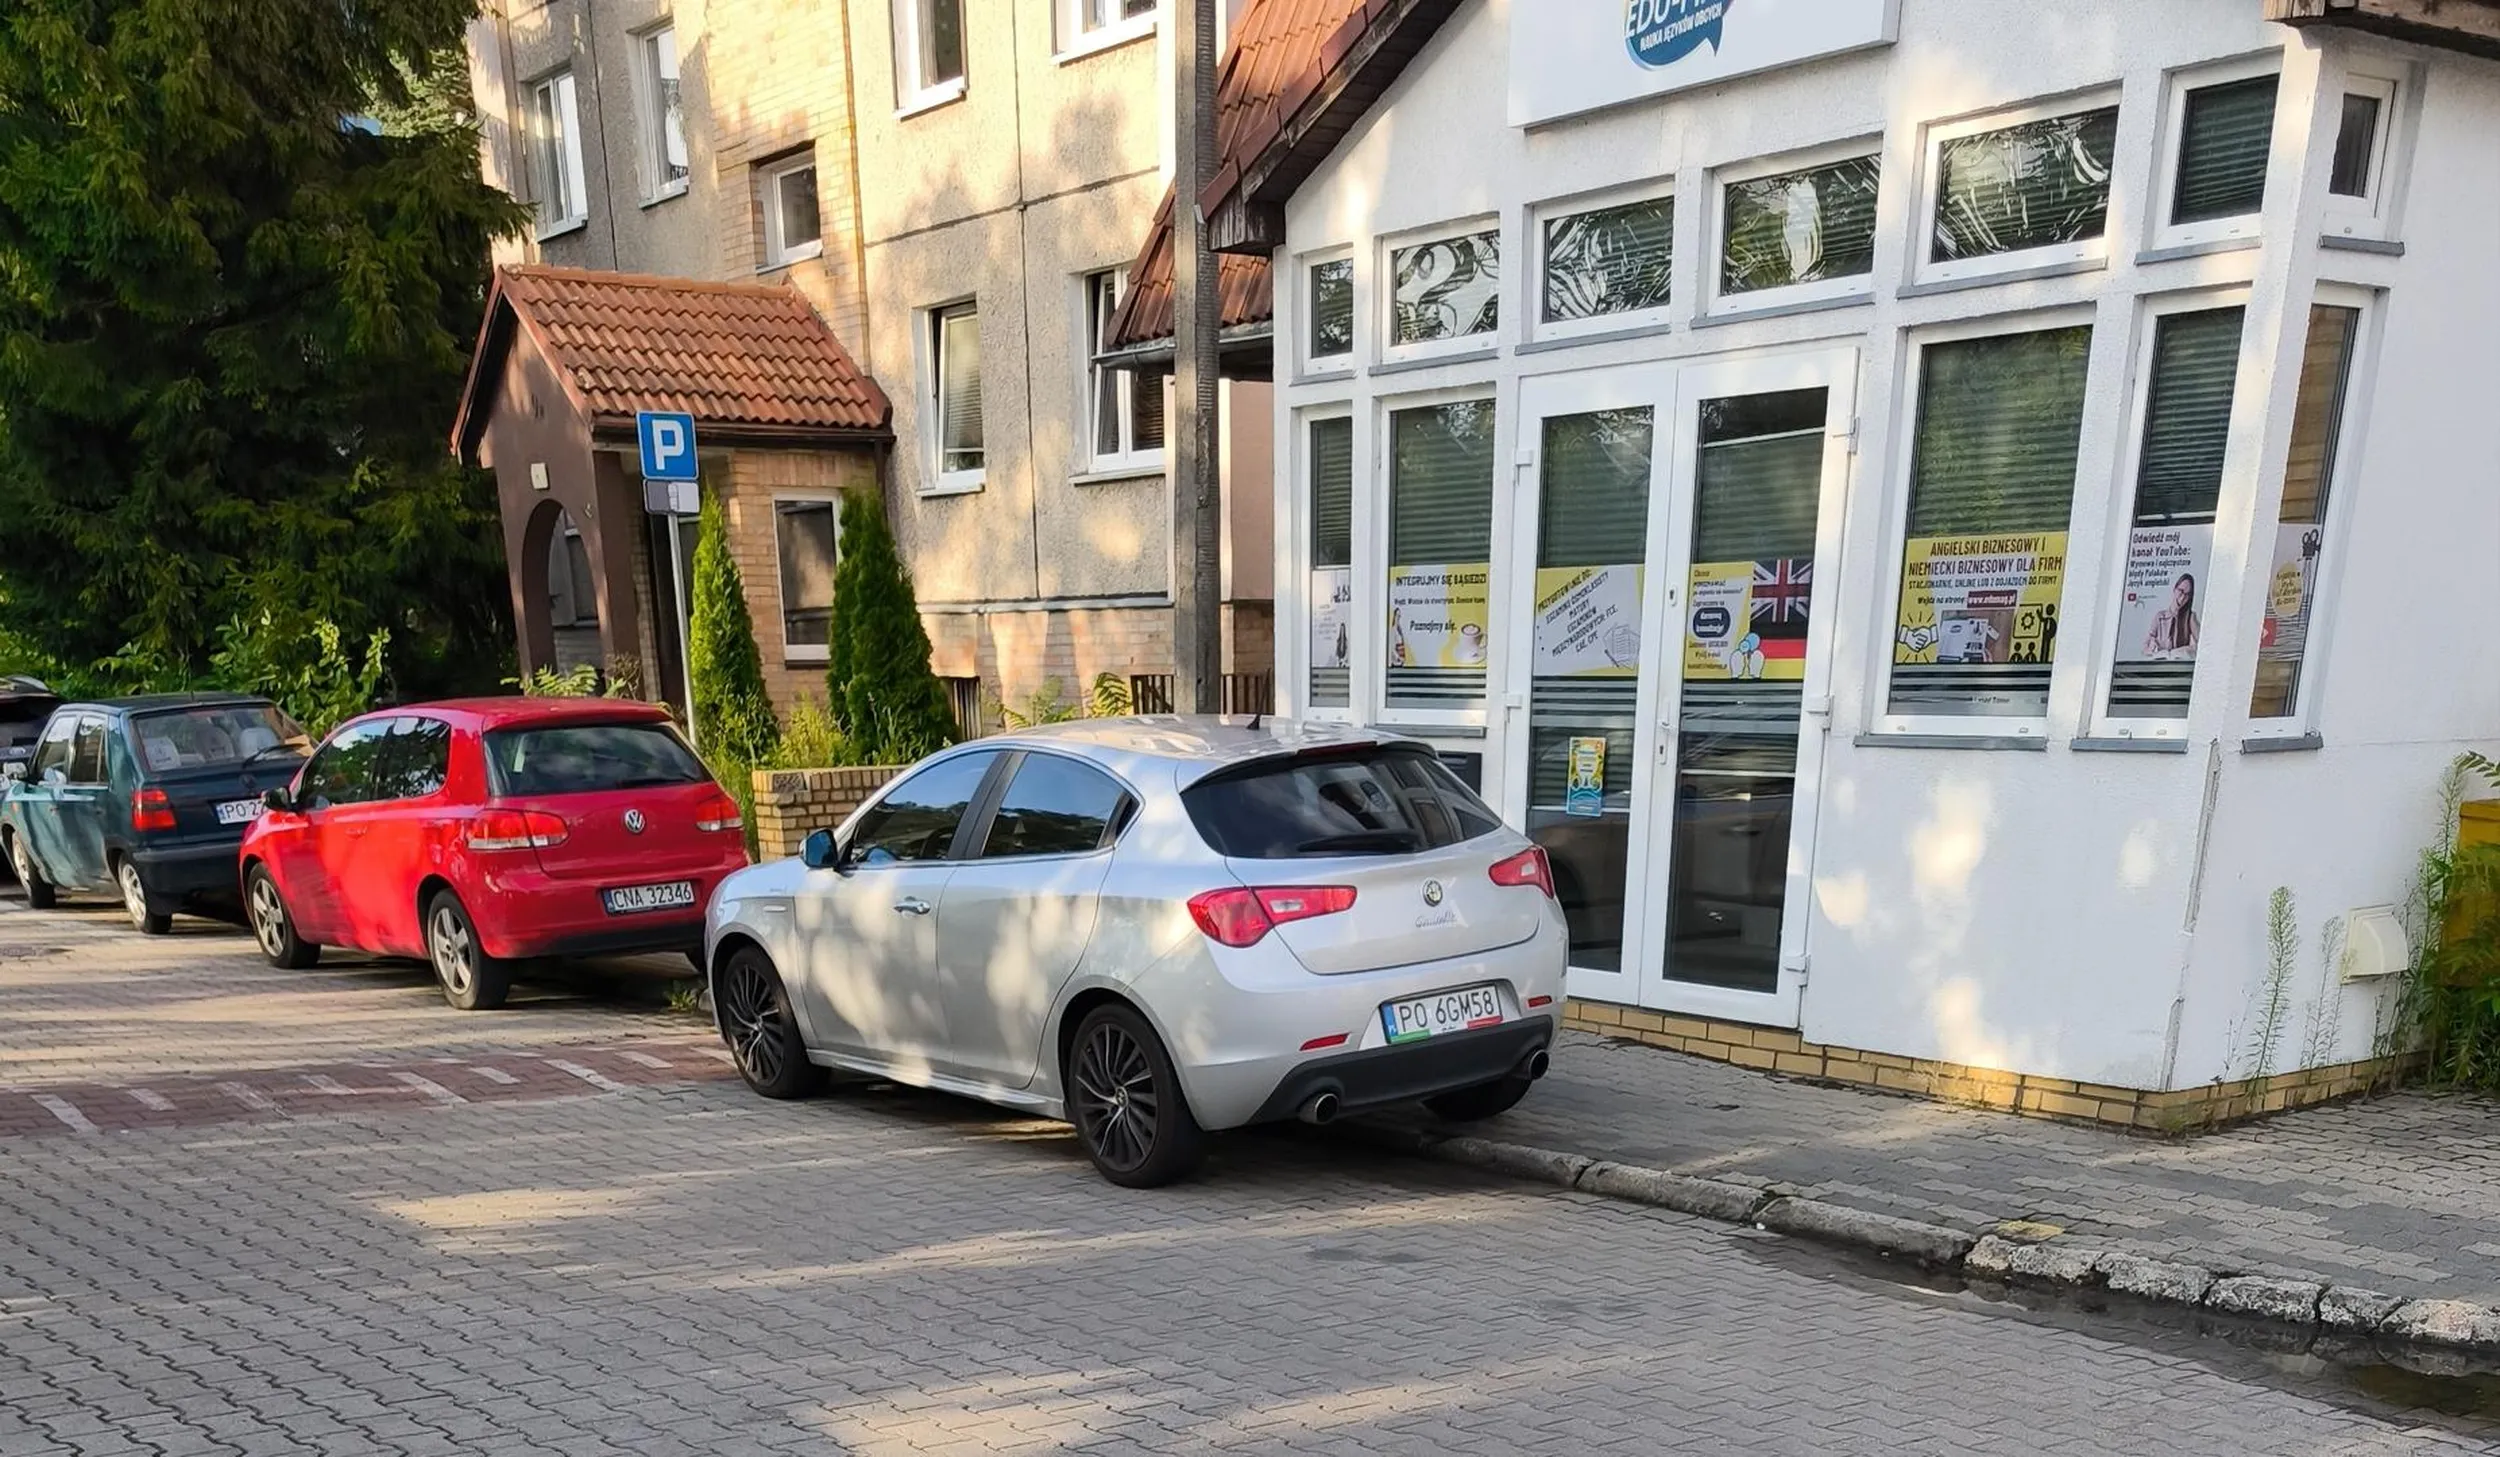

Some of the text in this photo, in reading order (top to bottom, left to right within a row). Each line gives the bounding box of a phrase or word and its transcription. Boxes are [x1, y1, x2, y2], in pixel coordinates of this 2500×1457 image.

[652, 419, 684, 471] P
[1930, 536, 2046, 557] ANGIELSKI BIZNESOWY I
[1908, 556, 2062, 576] NIEMIECKI BIZNESOWY DLA FIRM
[1955, 577, 1976, 588] ONLINE
[1977, 577, 1989, 587] LUB
[1995, 576, 2028, 587] DOJAZDEM
[2028, 576, 2037, 585] DO
[2037, 575, 2057, 585] FIRMY
[224, 803, 246, 819] PO
[613, 884, 692, 908] CNA 32346
[1399, 990, 1494, 1032] PO 6GM58
